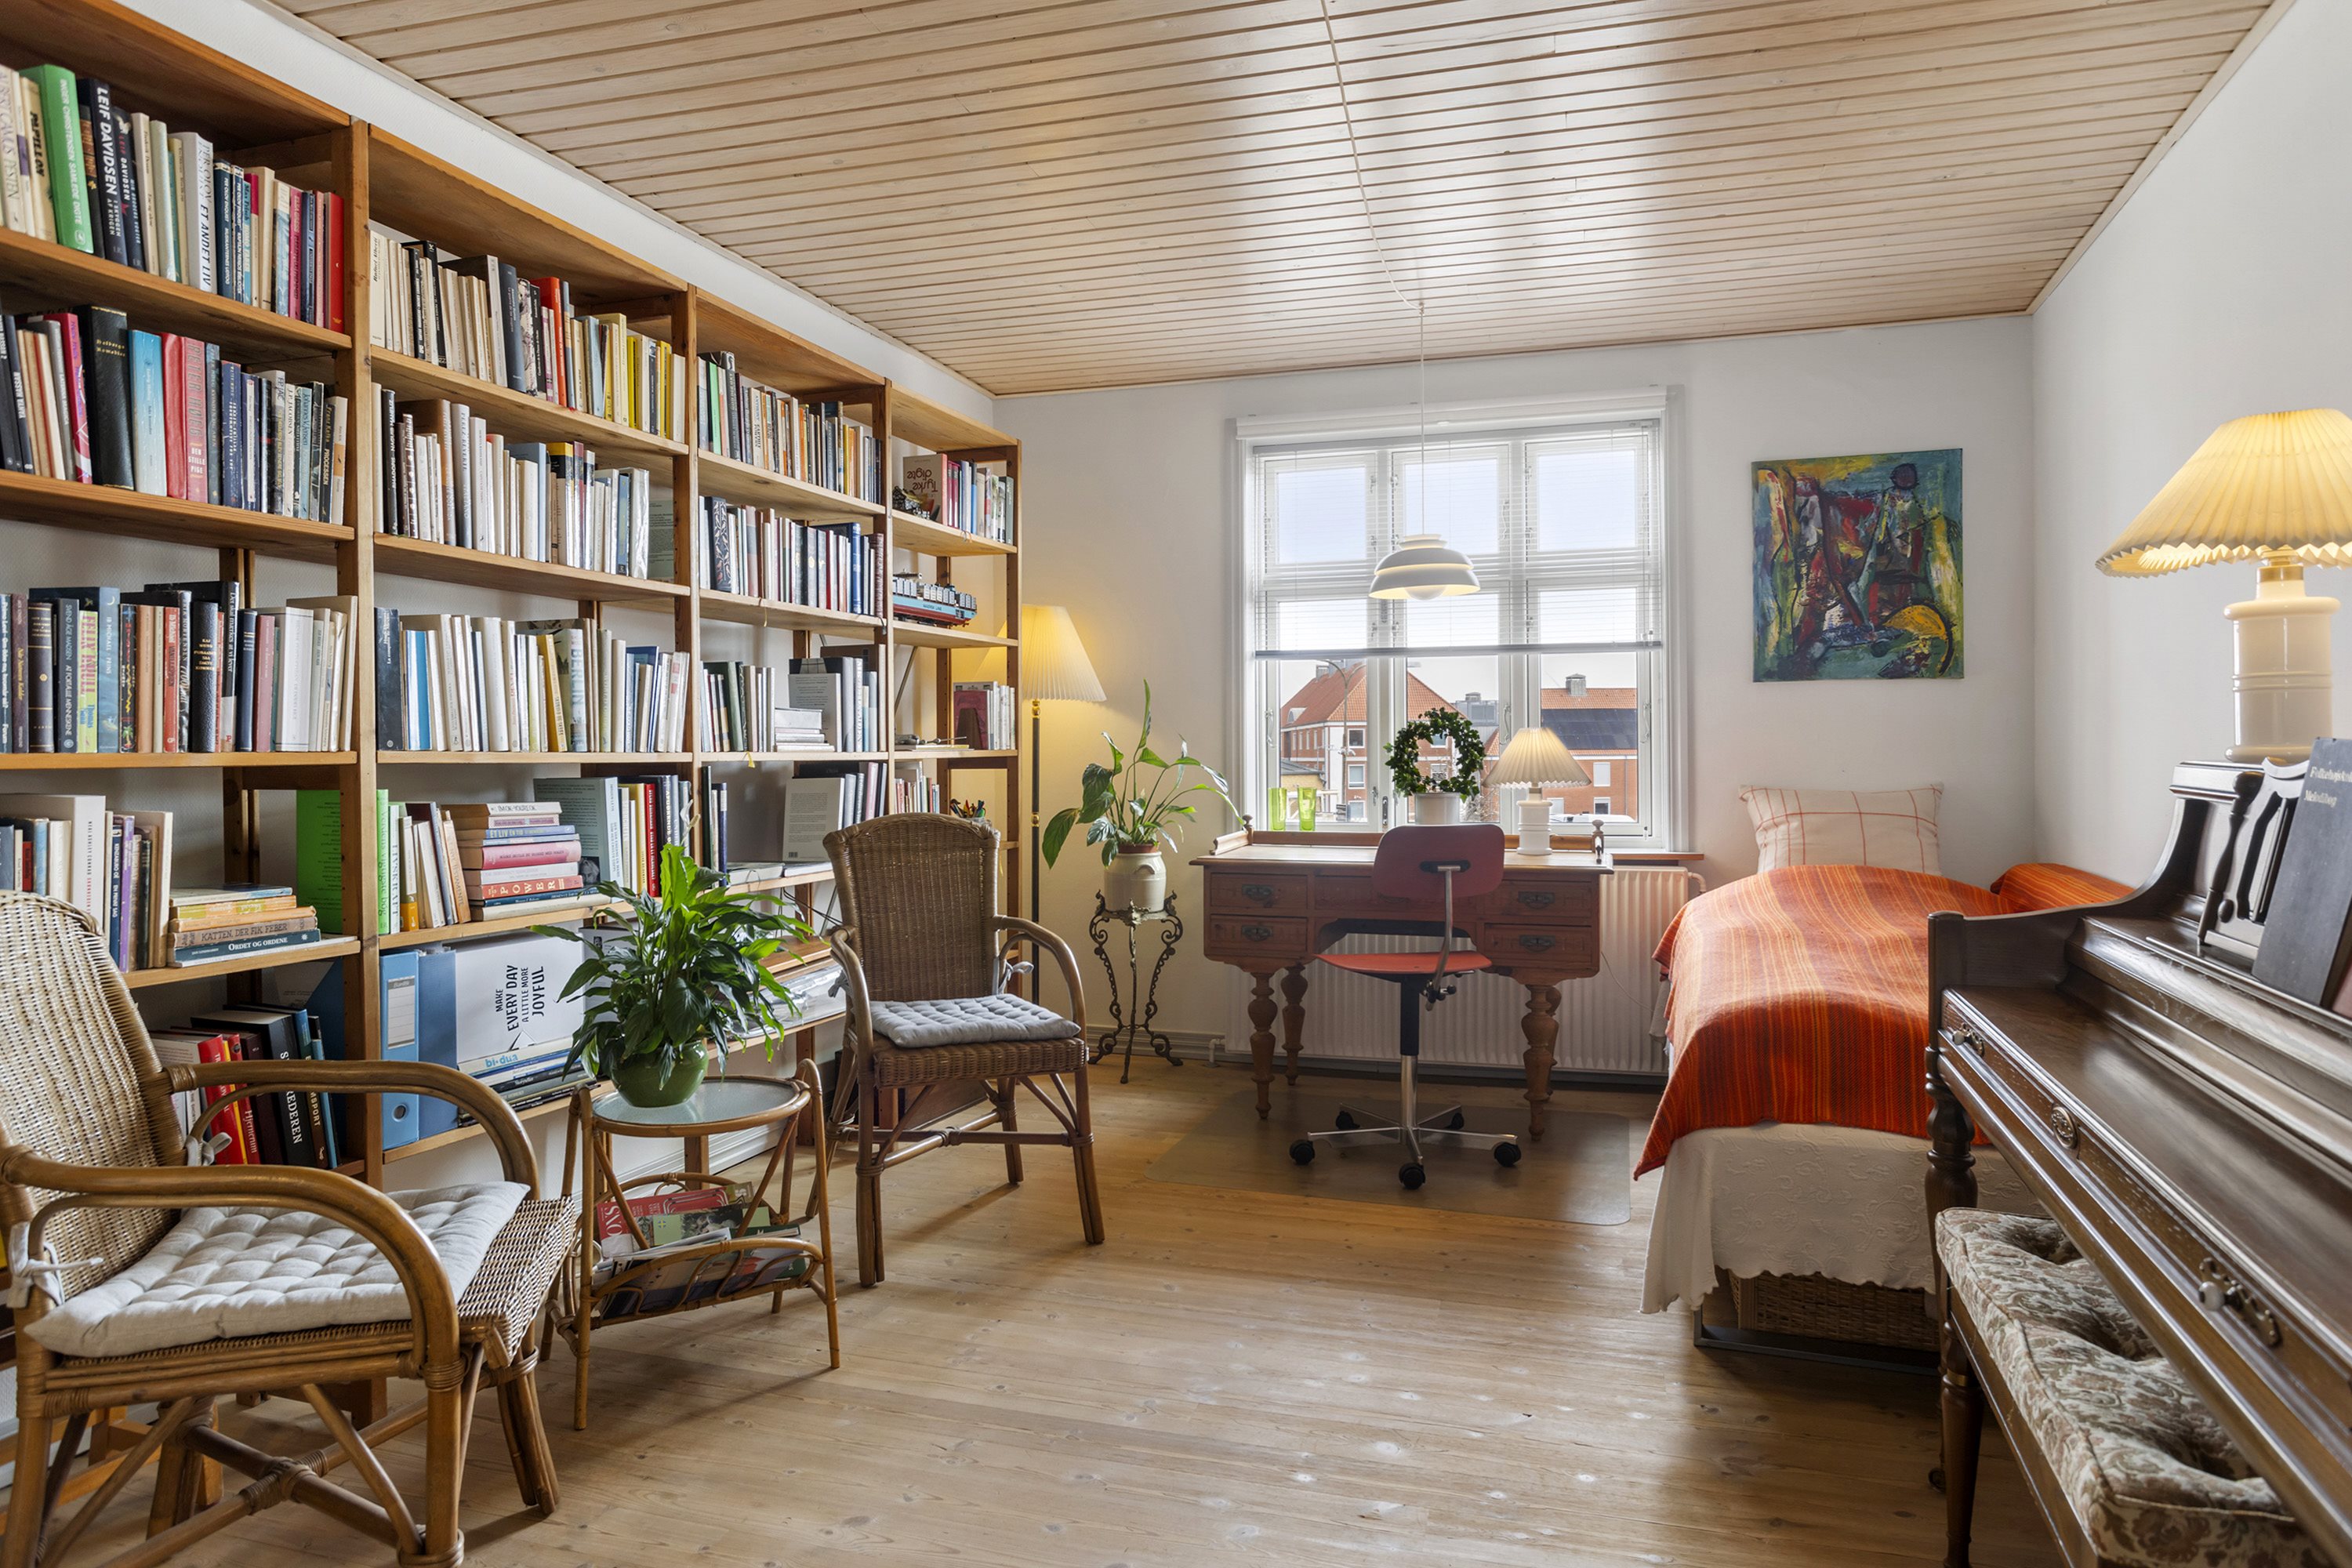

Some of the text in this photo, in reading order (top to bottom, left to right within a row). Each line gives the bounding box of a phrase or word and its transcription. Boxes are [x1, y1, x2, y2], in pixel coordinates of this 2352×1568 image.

[31, 112, 45, 176] PAPILLON
[60, 80, 82, 225] INGER CHRISTENSEN SAMLEDE DIGTE
[97, 88, 118, 194] LEIF DAVIDSEN
[121, 158, 129, 200] DAVIDSEN
[107, 198, 112, 207] AF
[200, 205, 212, 286] ET ANDET LIV
[13, 372, 23, 397] HASSAN
[187, 345, 202, 438] PETER HØEG
[275, 388, 284, 401] JAC
[188, 456, 205, 465] STILLE
[906, 467, 932, 480] digte
[911, 478, 938, 494] Tyske
[2, 637, 8, 648] Om
[167, 620, 176, 643] Michael
[80, 615, 96, 695] FELIX KRULL
[572, 648, 584, 705] BERLIN
[86, 704, 95, 728] Thomas
[378, 853, 388, 895] vigtigste
[452, 864, 463, 907] TESTAMENTE
[500, 880, 555, 895] POWER
[378, 897, 388, 916] bog
[201, 923, 287, 941] KATTEN, DER FIK FEBER
[506, 965, 519, 1032] EVERY DAY
[532, 966, 545, 1017] JOYFUL
[243, 1110, 257, 1153] Hjernerum
